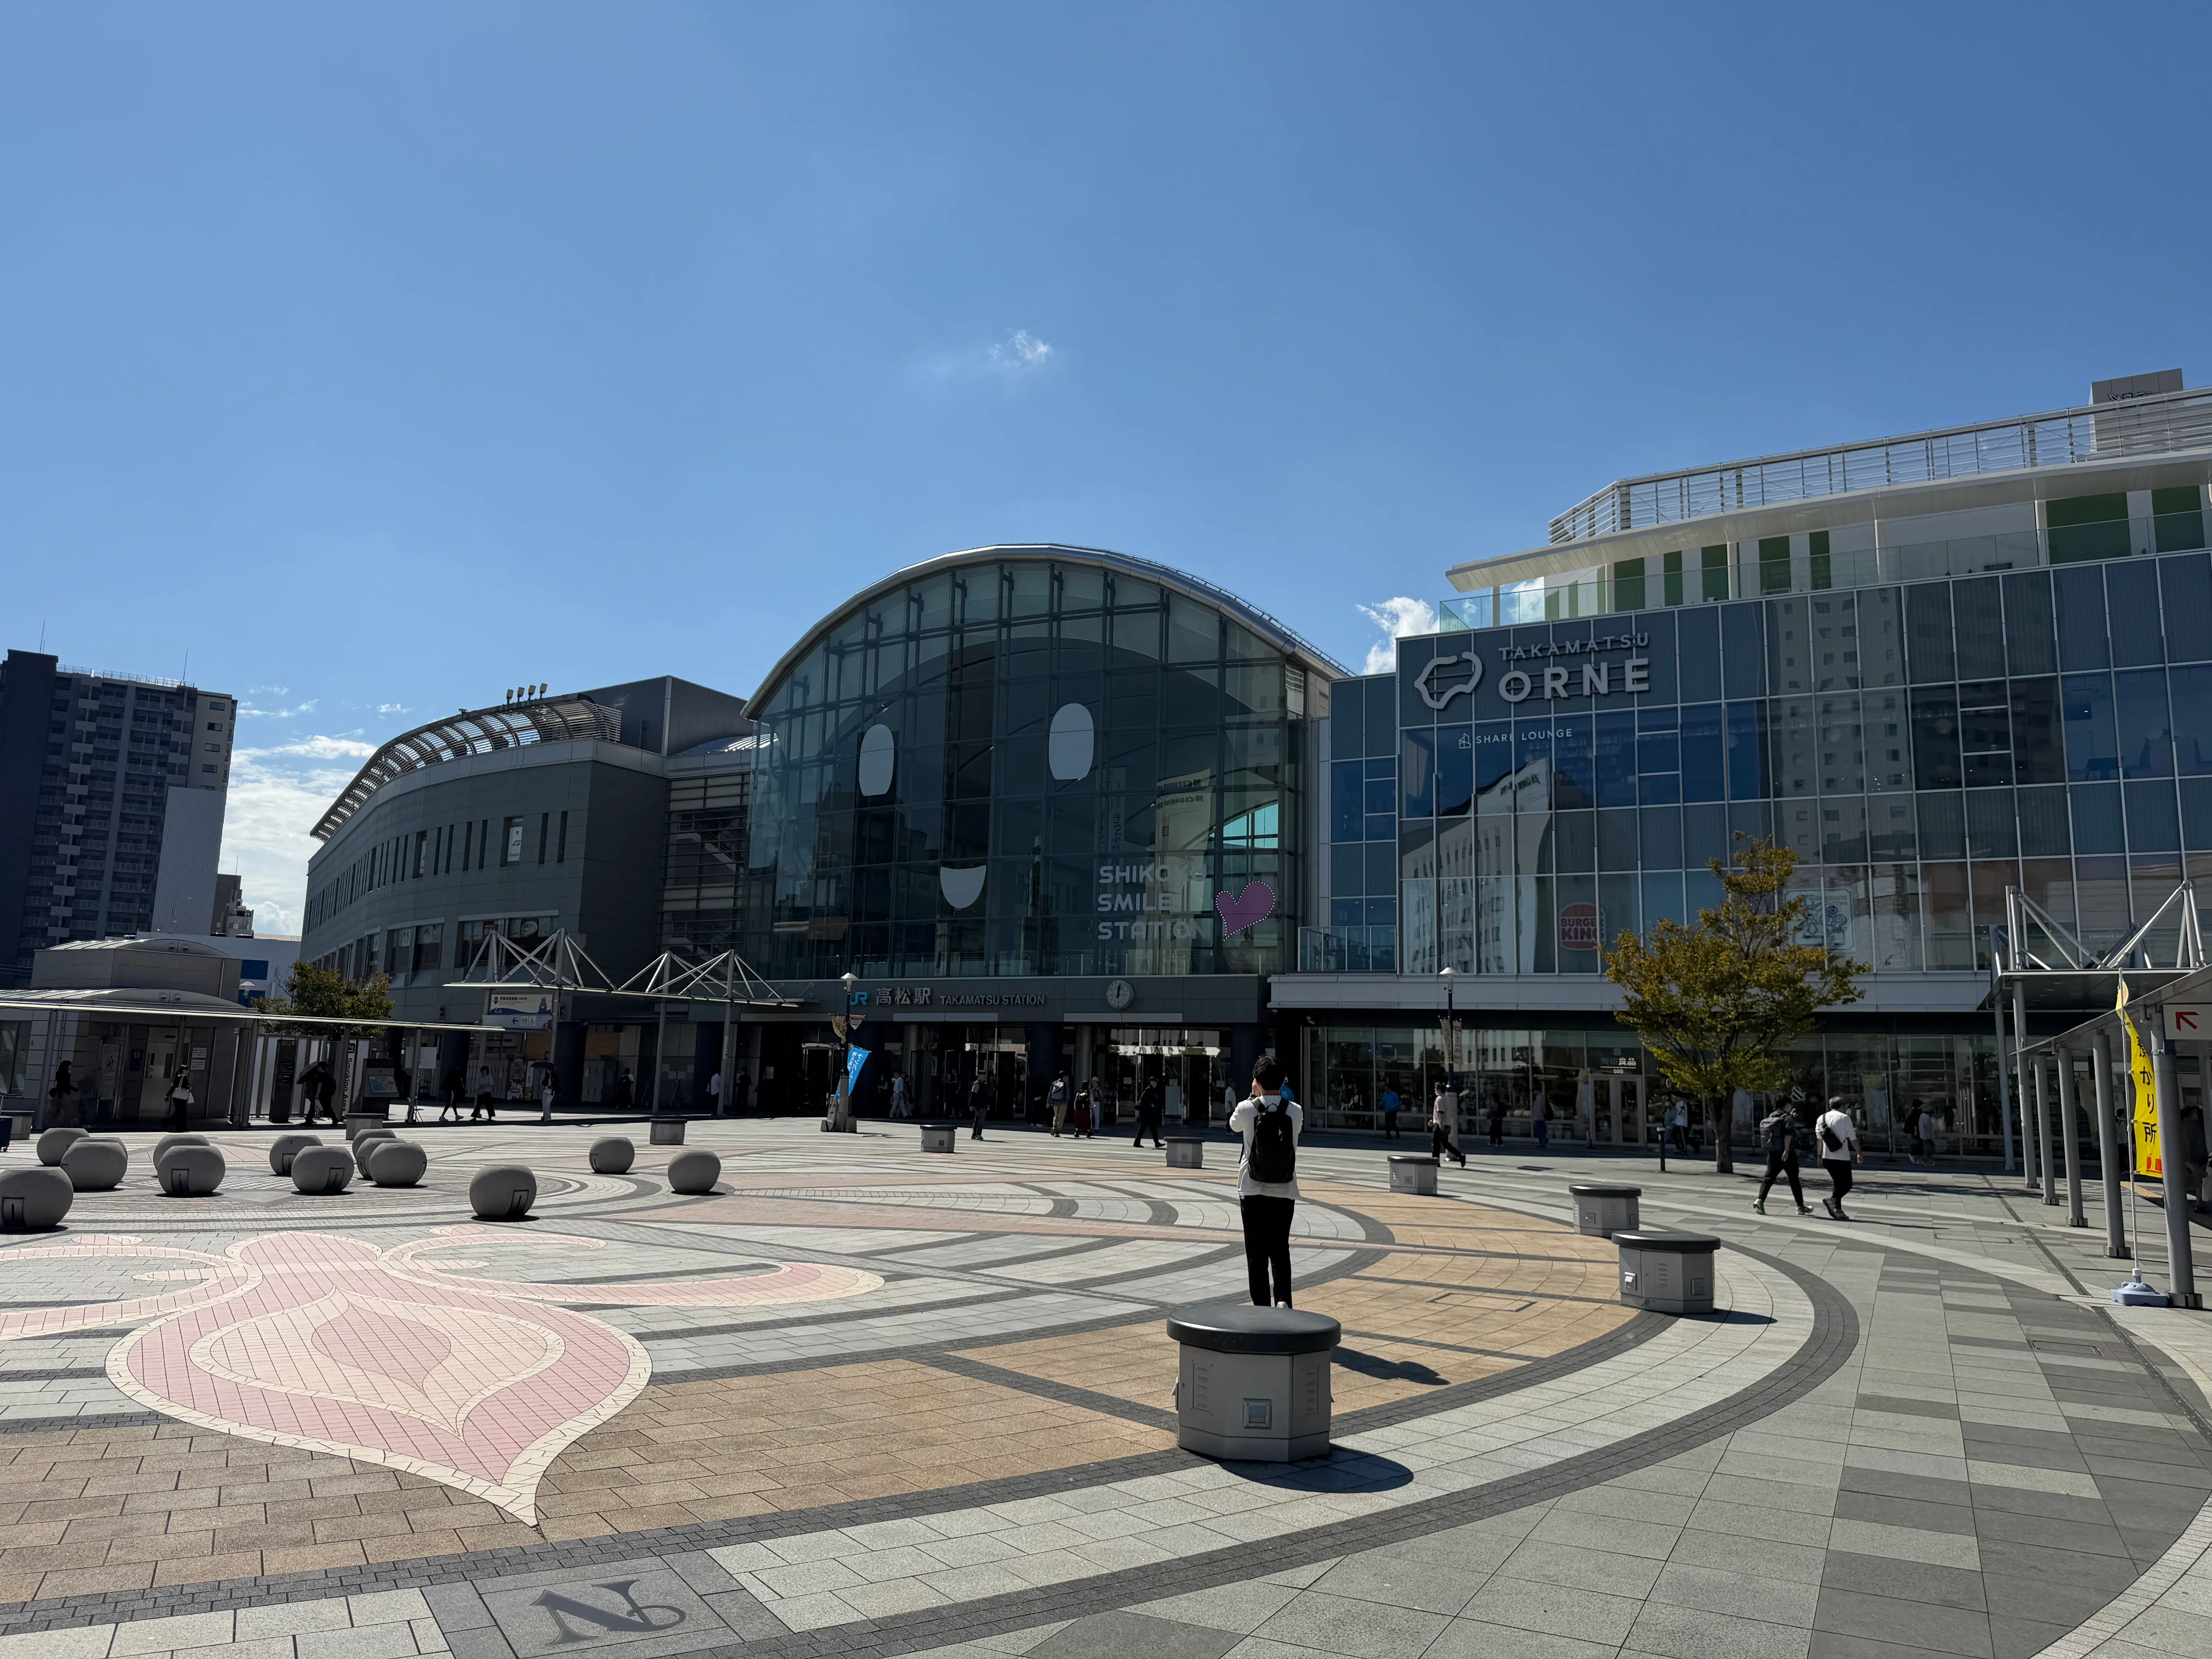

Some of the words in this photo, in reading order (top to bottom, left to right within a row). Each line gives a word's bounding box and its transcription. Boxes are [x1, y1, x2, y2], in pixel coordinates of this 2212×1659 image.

[1498, 632, 1649, 660] TAKAMATSU
[1498, 658, 1649, 702] ORNE
[1522, 728, 1573, 740] LOUNGE
[1099, 864, 1207, 883] SHIKOKU
[1097, 893, 1173, 911] SMILE
[1098, 921, 1207, 939] STATION
[850, 991, 869, 1006] JR
[876, 987, 931, 1005] 高松駅
[940, 995, 1000, 1005] TAKAMATSU
[1002, 994, 1044, 1005] STATION
